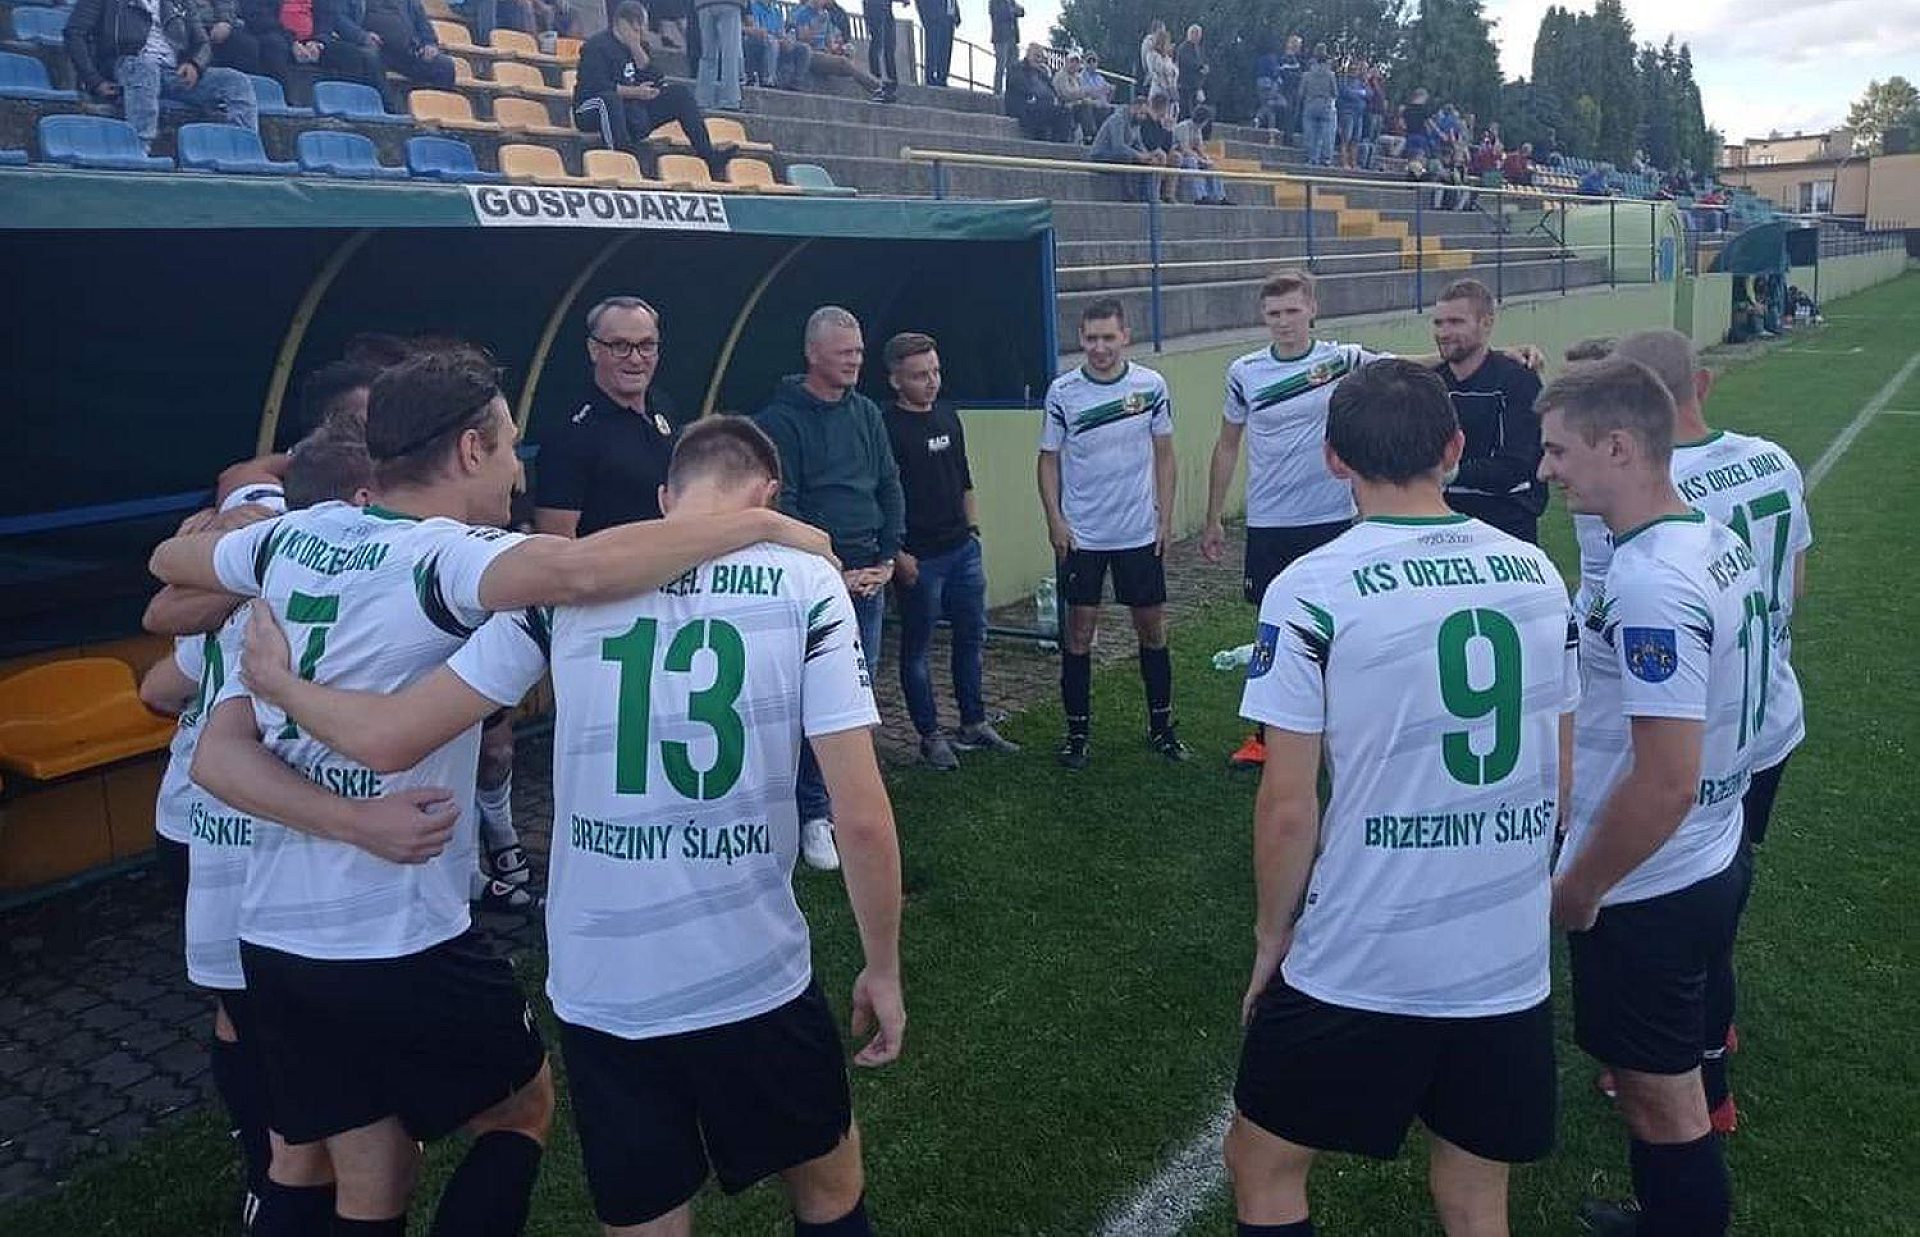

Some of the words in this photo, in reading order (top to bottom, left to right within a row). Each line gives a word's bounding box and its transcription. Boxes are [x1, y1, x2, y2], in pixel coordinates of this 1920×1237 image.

[476, 187, 725, 223] GOSPODARZE
[1678, 475, 1707, 502] KS
[711, 564, 783, 597] BIAŁY
[1352, 562, 1398, 598] KS
[601, 616, 746, 800] 13
[1437, 607, 1523, 786] 9
[571, 813, 673, 860] BRZEZINY
[1365, 811, 1487, 849] BRZEZINY
